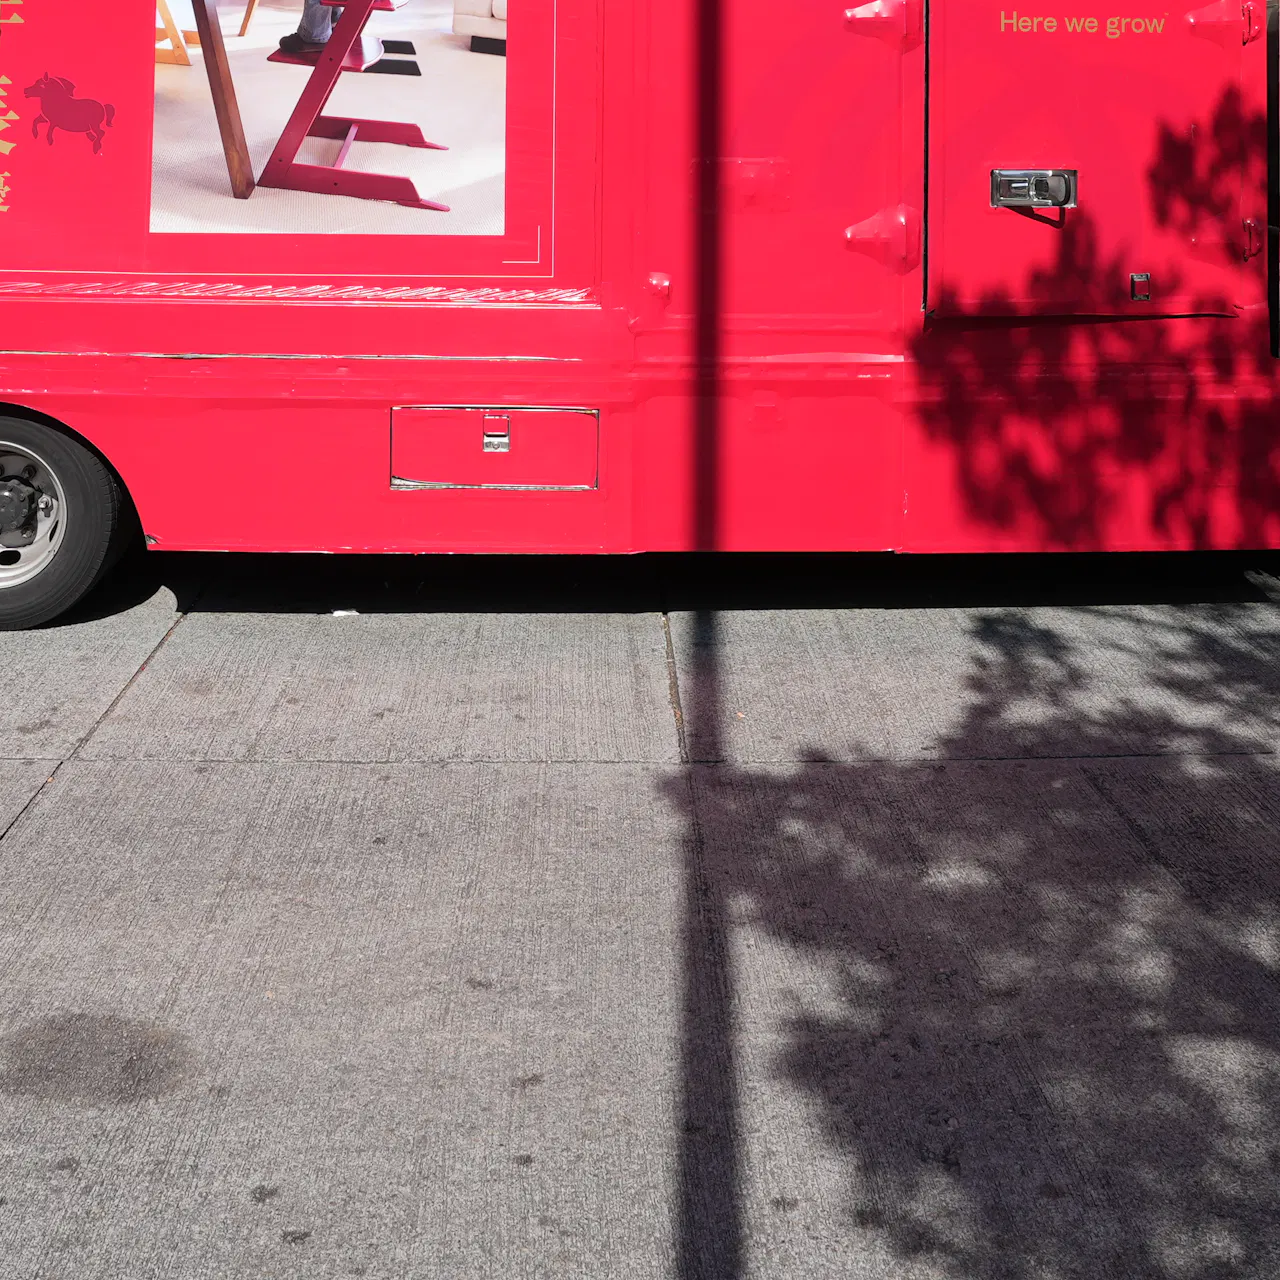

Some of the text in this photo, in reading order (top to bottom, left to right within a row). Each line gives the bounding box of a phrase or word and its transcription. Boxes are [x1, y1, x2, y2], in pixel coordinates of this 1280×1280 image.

[1000, 11, 1166, 39] Here we grow
